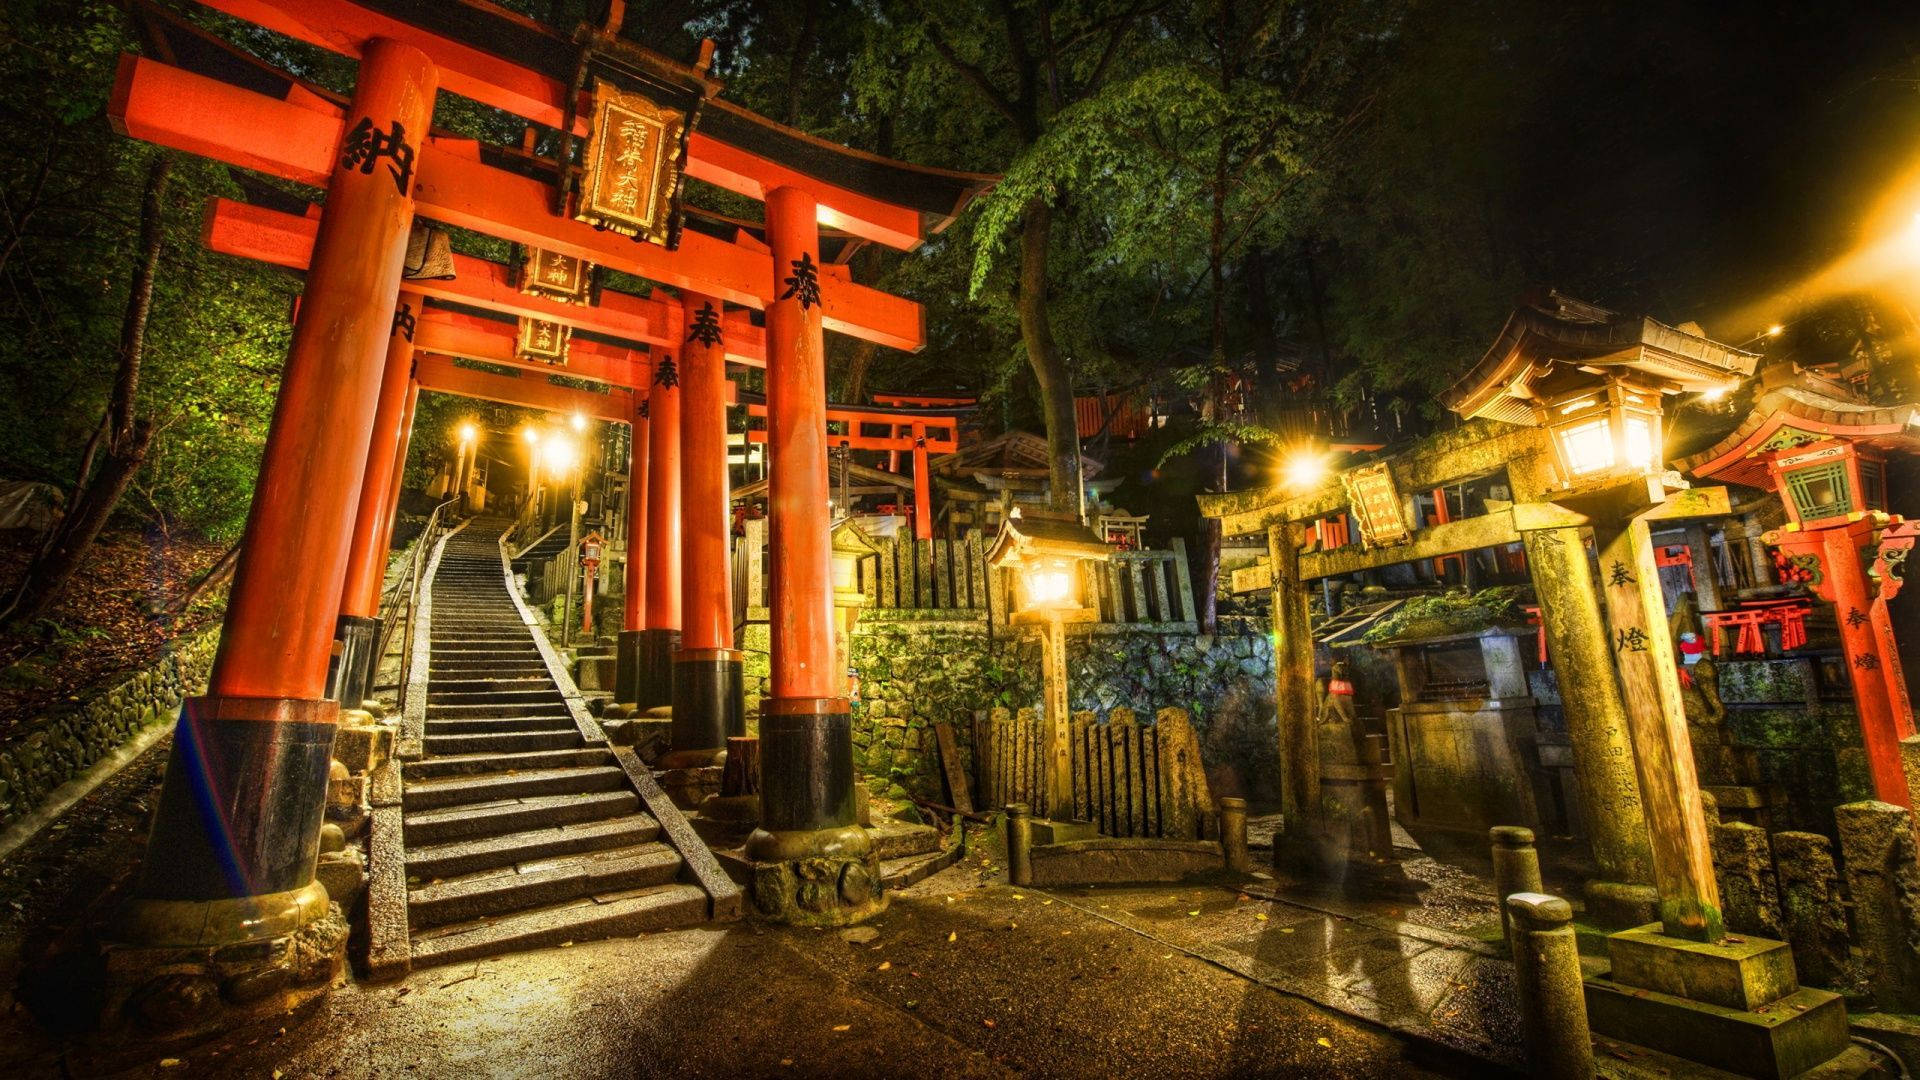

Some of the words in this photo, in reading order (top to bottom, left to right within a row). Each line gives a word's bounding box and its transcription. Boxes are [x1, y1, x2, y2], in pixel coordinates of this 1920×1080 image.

[341, 115, 414, 197] 納
[780, 251, 822, 310] 奉
[686, 301, 724, 349] 奉
[654, 354, 680, 391] 奉
